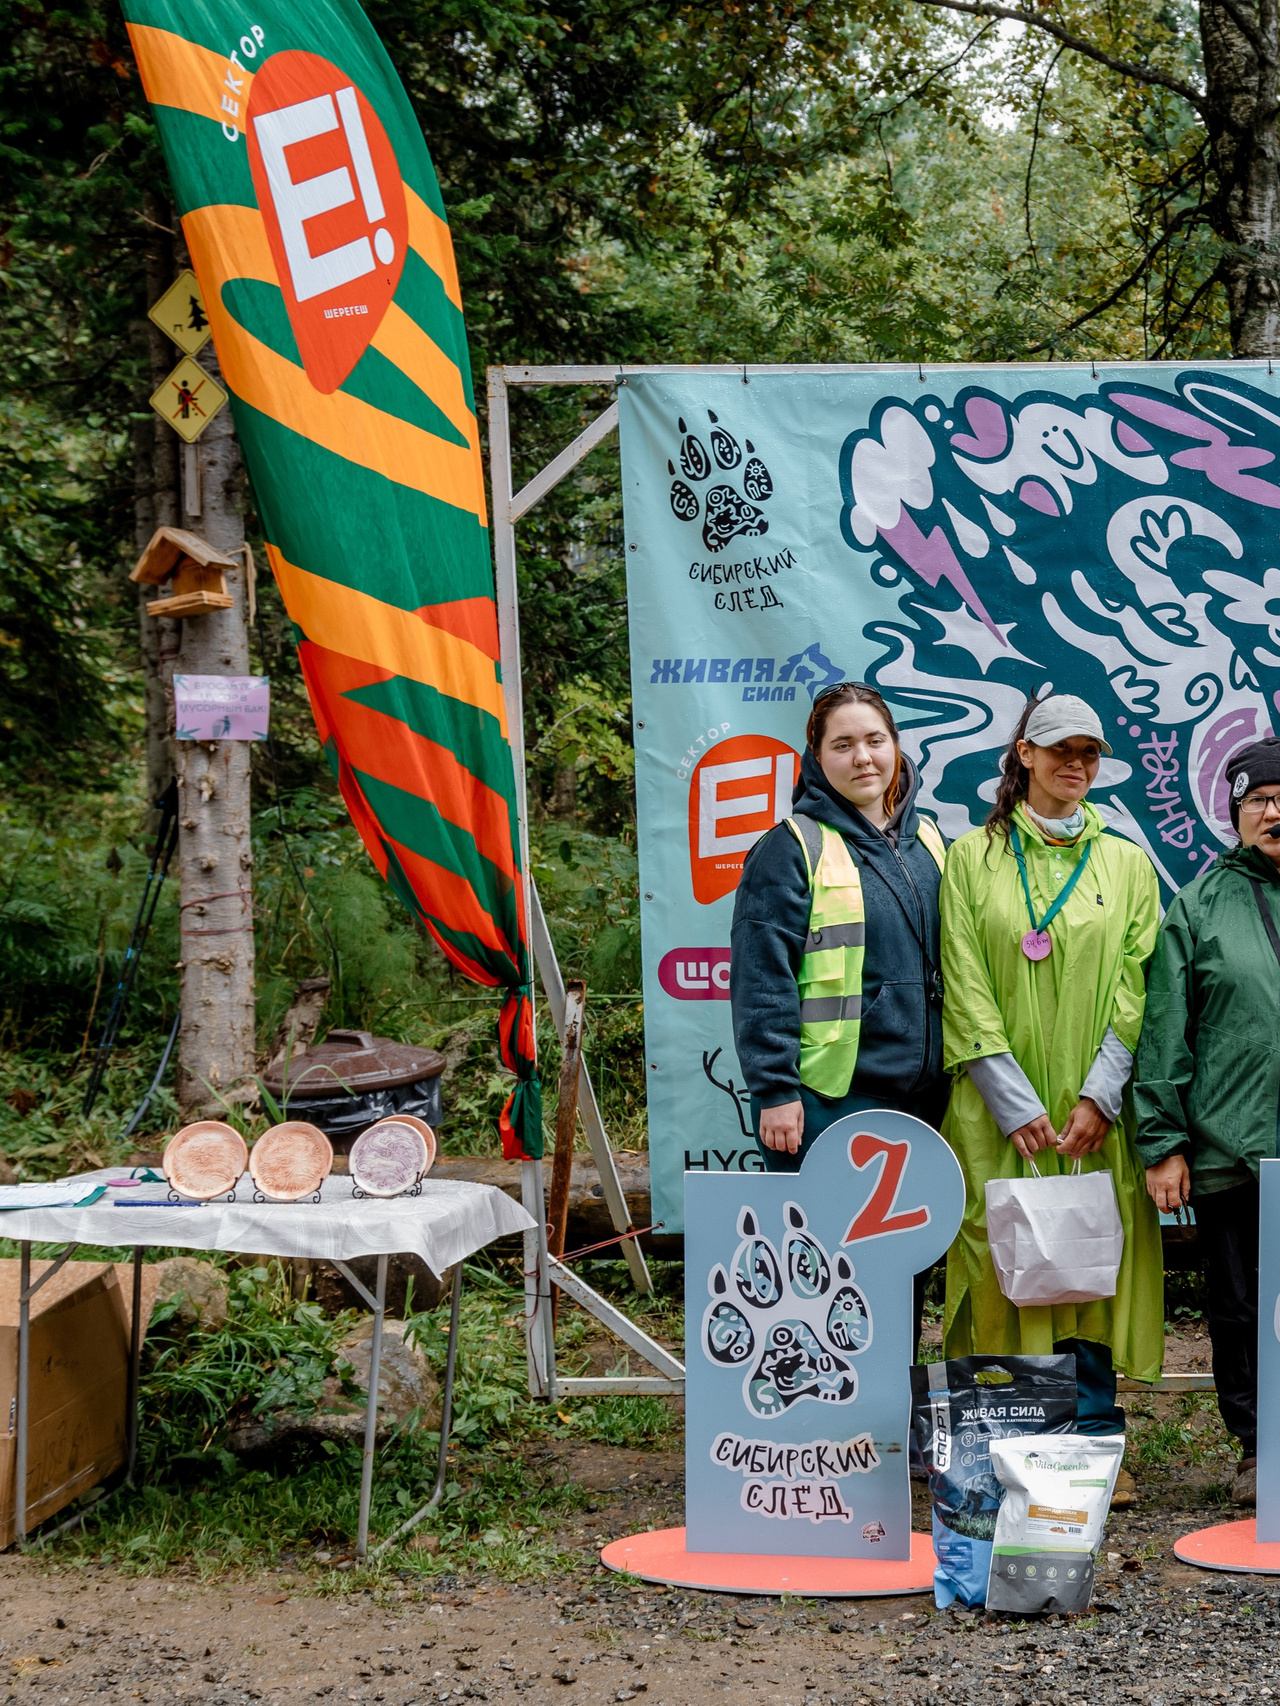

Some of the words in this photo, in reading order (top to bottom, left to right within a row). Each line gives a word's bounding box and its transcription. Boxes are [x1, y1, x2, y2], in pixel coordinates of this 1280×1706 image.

[221, 24, 267, 142] СЕКТОР
[324, 304, 369, 319] ШЕРЕГЕШ
[689, 548, 797, 585] СИБИРСКИЙ
[650, 658, 776, 684] ЖИВАЯ
[742, 686, 796, 702] СИЛА
[676, 722, 731, 781] СЕКТОР
[685, 1150, 765, 1171] HYG
[842, 1133, 930, 1244] 2
[961, 1407, 1007, 1421] ЖИВАЯ
[1010, 1406, 1046, 1417] СИЛА
[936, 1403, 948, 1468] СПОРТ
[716, 1435, 877, 1478] СИБИРСКИЙ
